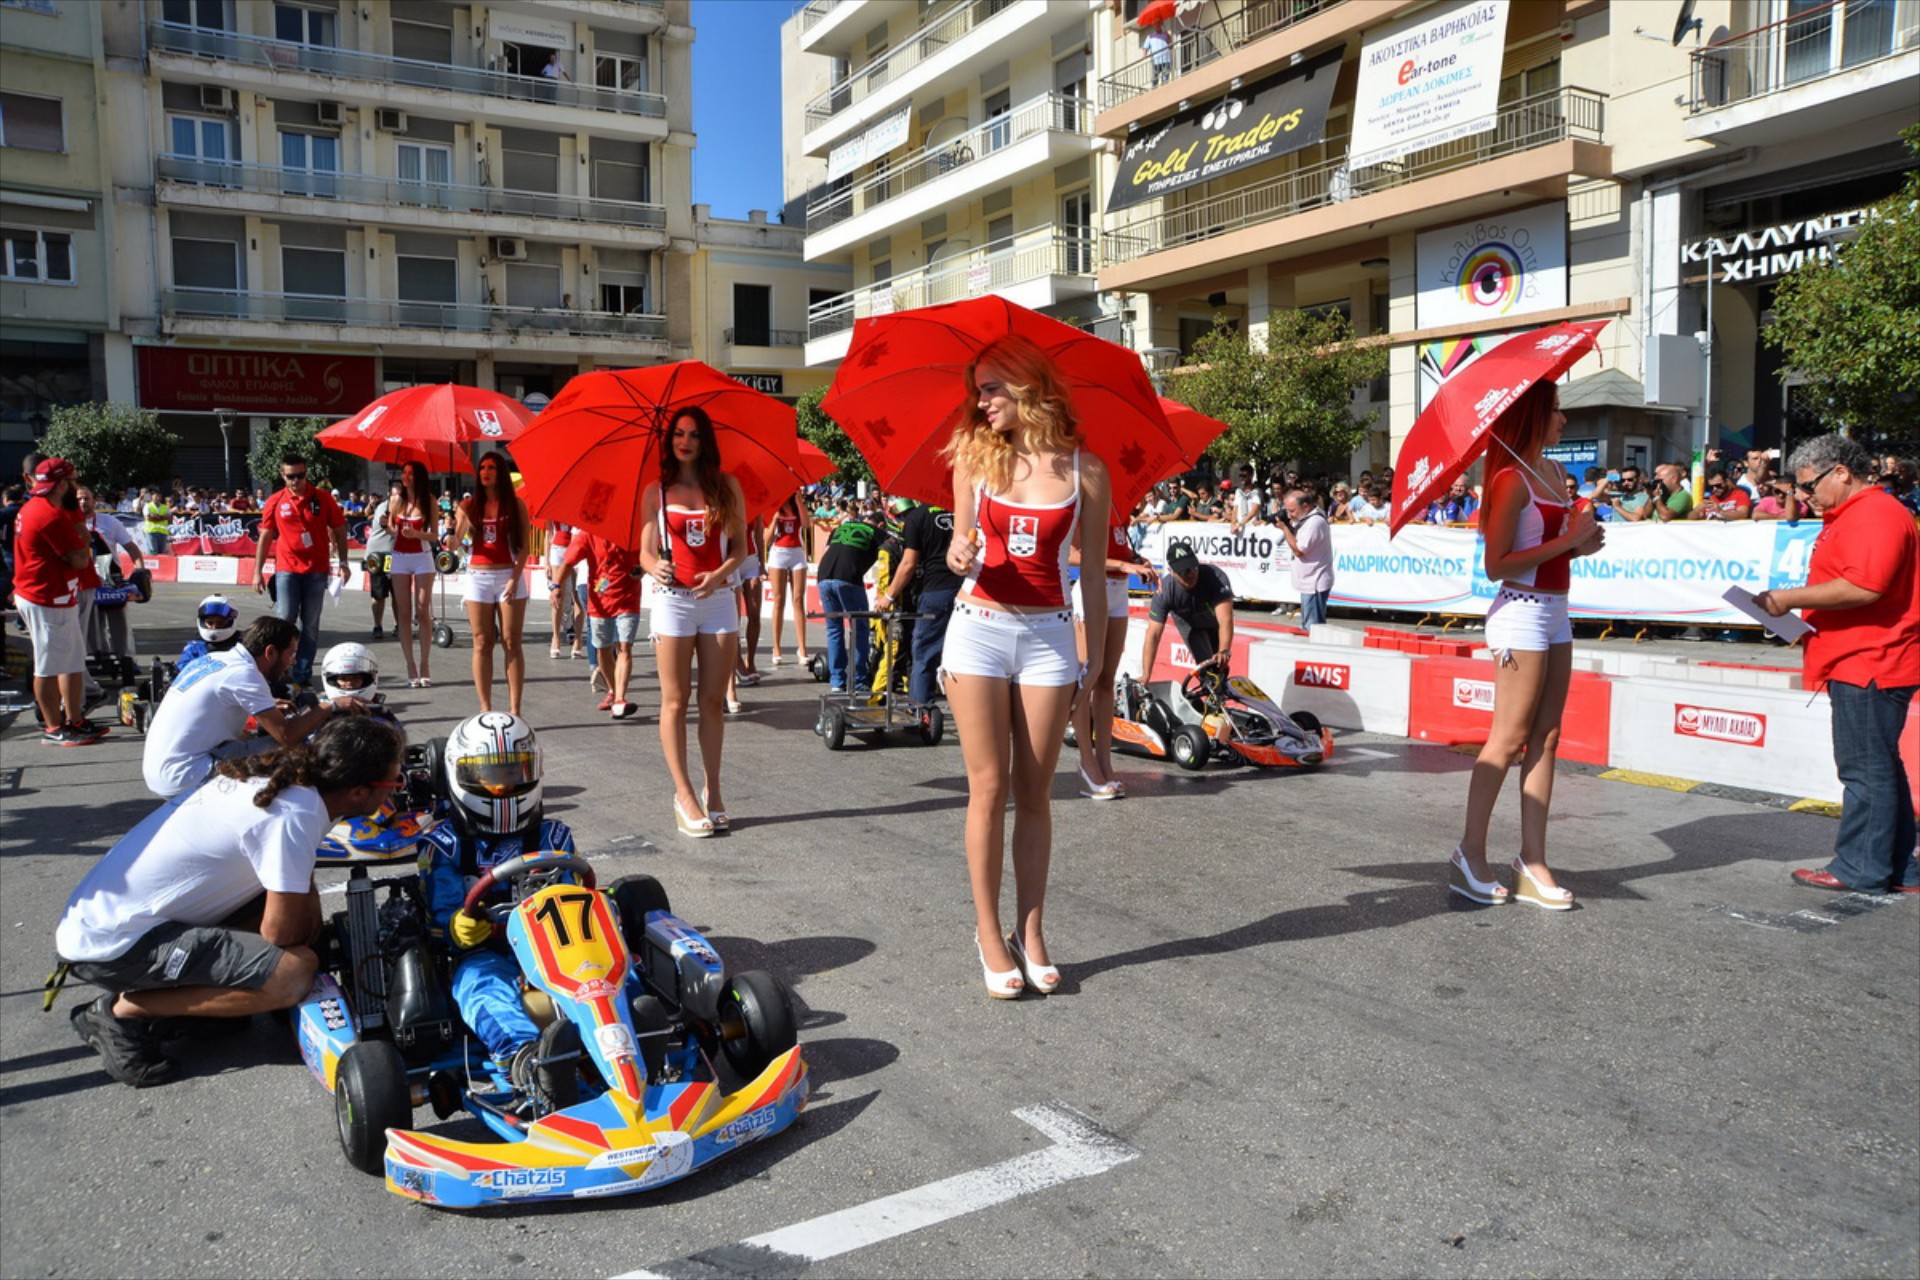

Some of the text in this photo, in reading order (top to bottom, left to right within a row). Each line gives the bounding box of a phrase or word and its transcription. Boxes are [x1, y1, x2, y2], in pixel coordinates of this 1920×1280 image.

[1368, 33, 1427, 67] ΑΚΟΥΣΤΙΚΑ
[1430, 4, 1497, 44] ΒΑΡΗΚΟΪΑΣ
[1397, 53, 1458, 85] ear-tone
[1379, 66, 1473, 108] ΔΩΡΕΑΝ ΔΟΚΙΜΕΣ
[1132, 140, 1199, 185] Gold
[1203, 108, 1304, 163] Traders
[188, 354, 305, 378] ΟΠΤΙΚΑ
[200, 379, 296, 392] ΦΑΚΟΙ ΕΠΑΦΗΣ
[1337, 554, 1467, 576] ΑΝΔΡΙΚΟΠΟΥΛΟΣ
[1570, 558, 1761, 581] ΑΝΔΡΙΚΟΠΟΥΛΟΣ
[1300, 666, 1343, 686] AVIS
[535, 893, 594, 947] 17
[726, 1107, 776, 1139] Chatzis
[491, 1169, 566, 1187] Chatzis
